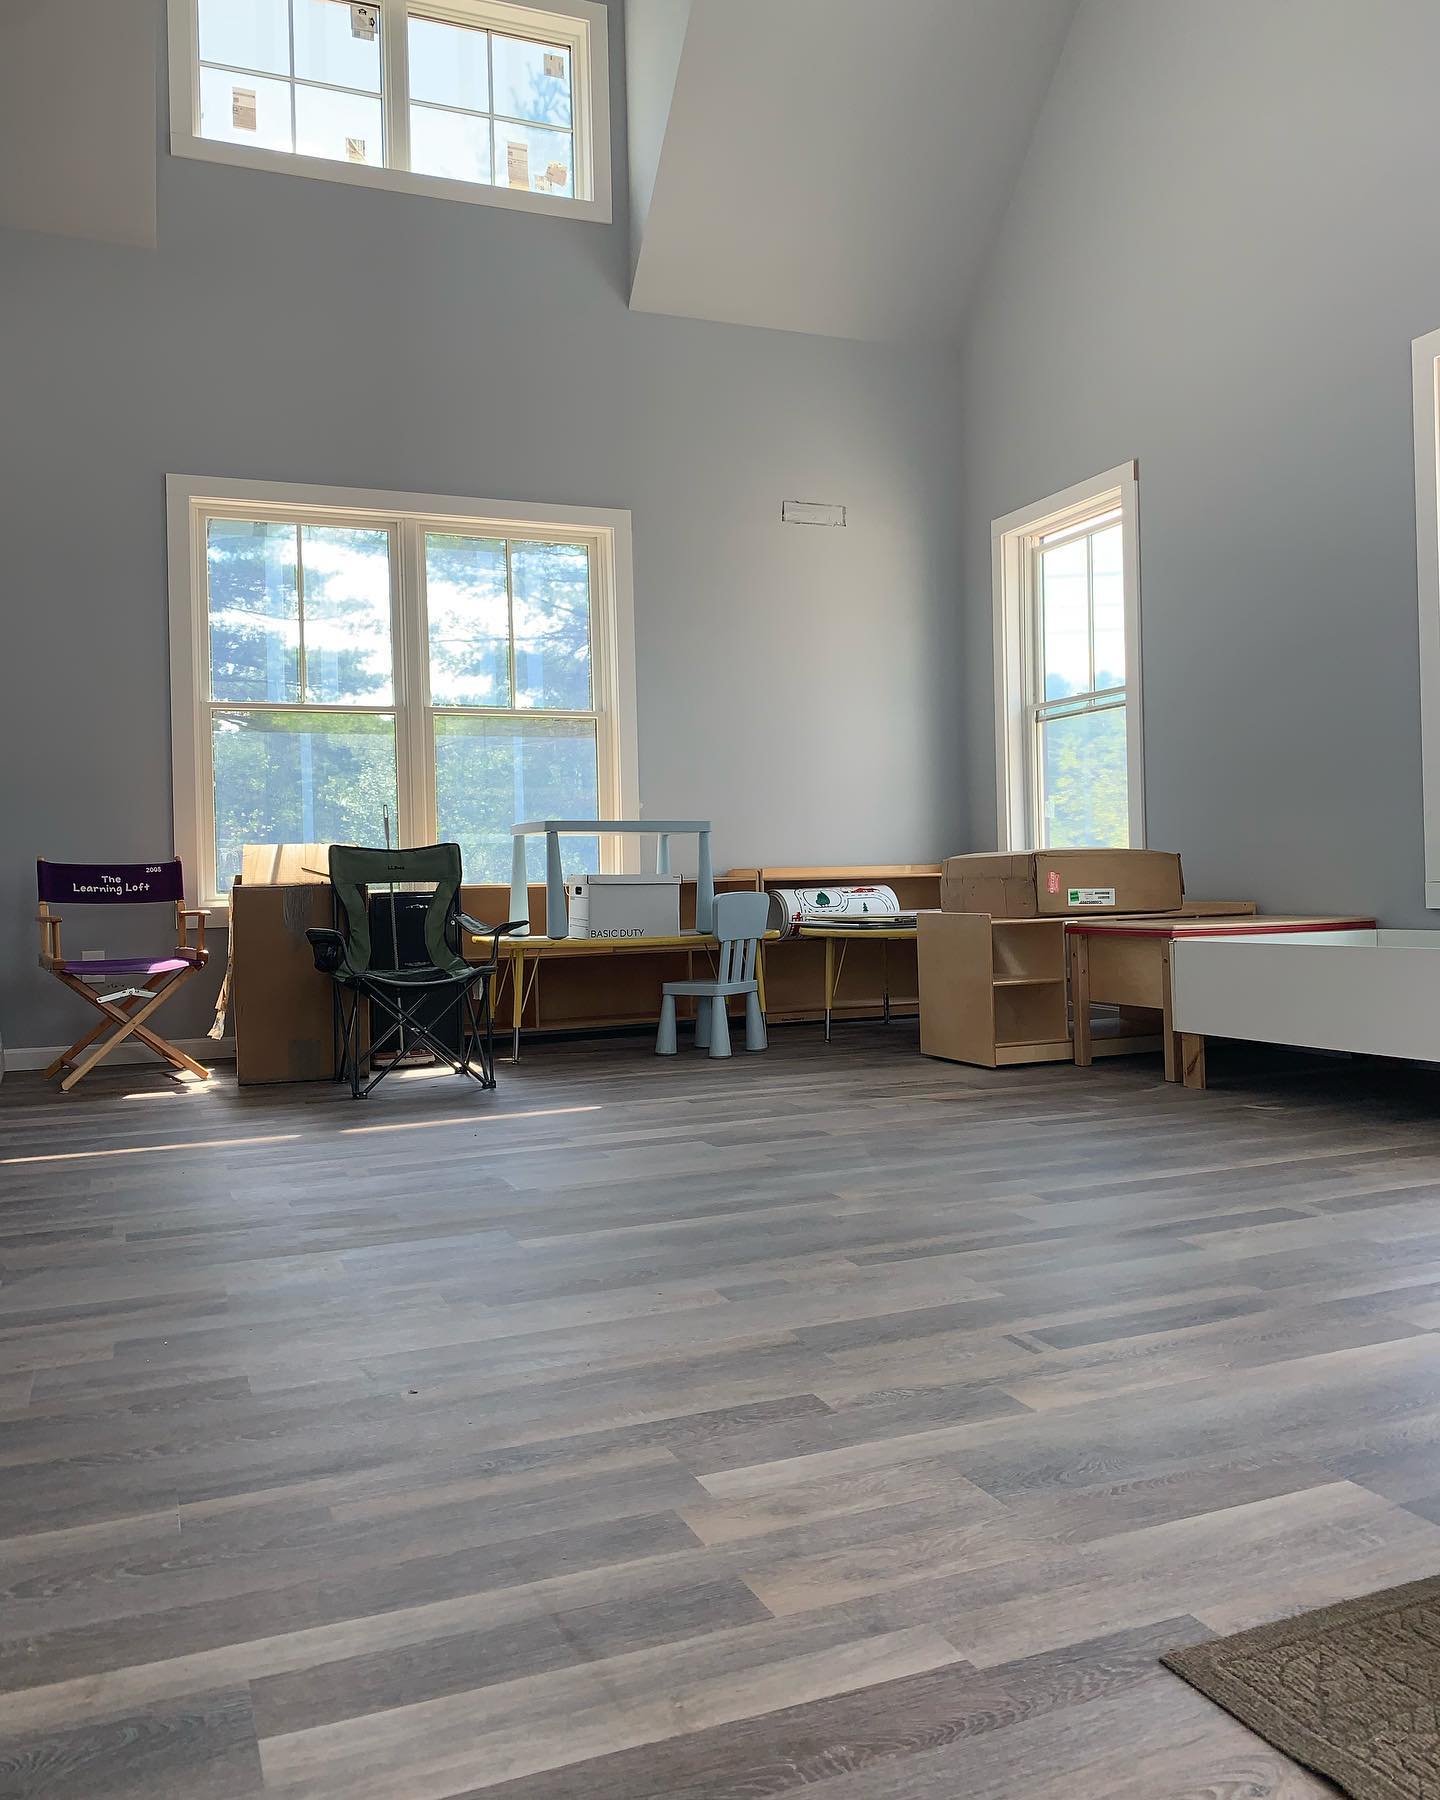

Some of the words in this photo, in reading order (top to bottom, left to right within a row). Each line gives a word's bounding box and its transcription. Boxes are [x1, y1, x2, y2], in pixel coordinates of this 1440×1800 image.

[101, 875, 122, 884] The
[72, 883, 123, 895] Learning
[125, 882, 150, 892] Loft
[590, 929, 618, 938] BASIC
[620, 928, 645, 937] DUTY
